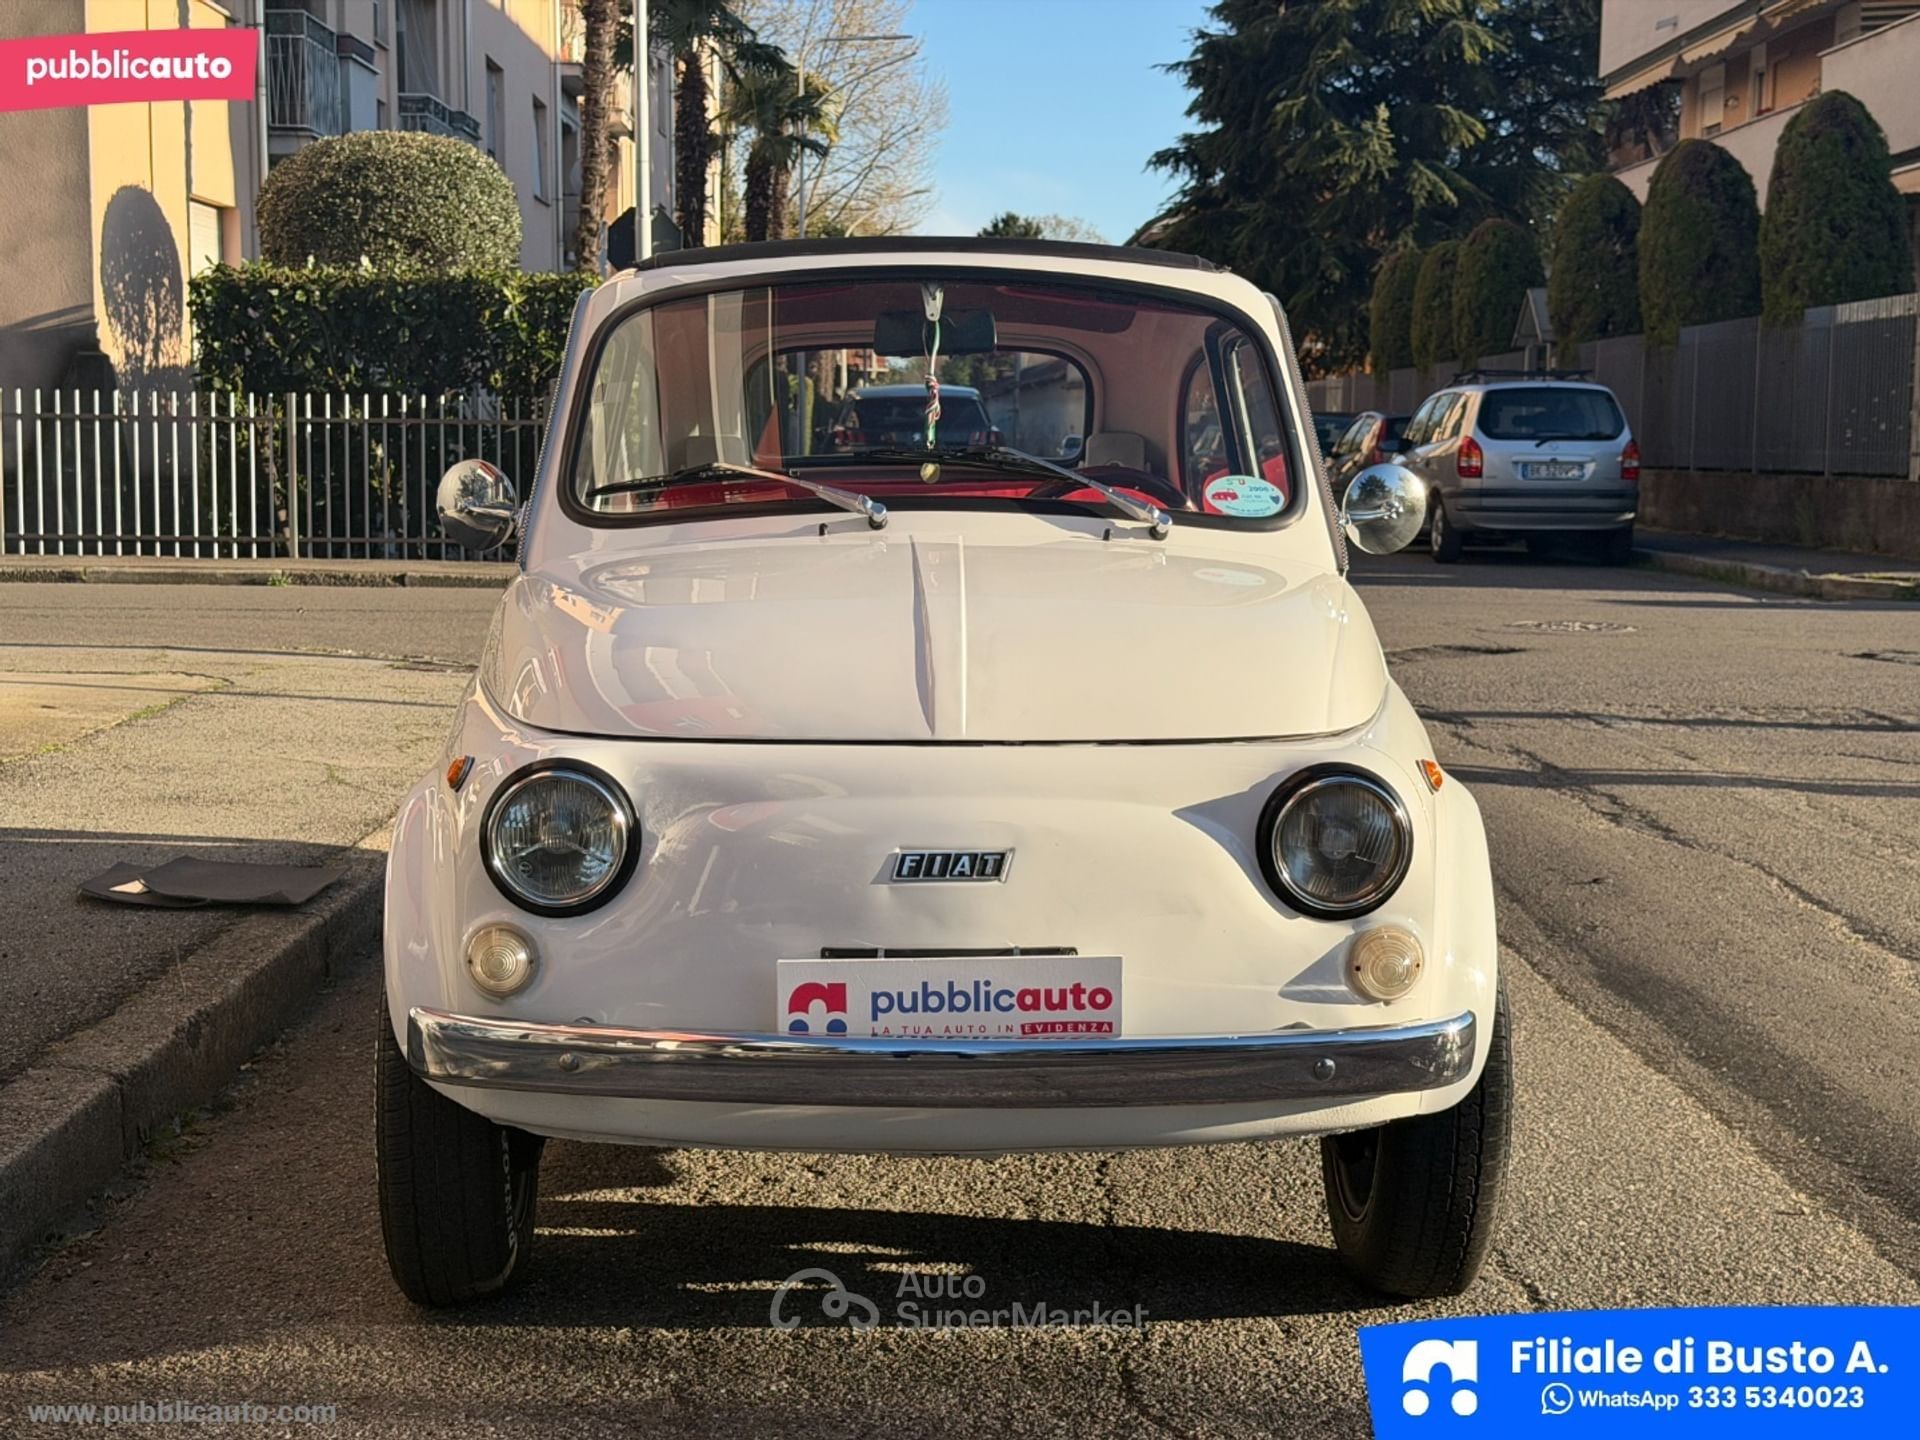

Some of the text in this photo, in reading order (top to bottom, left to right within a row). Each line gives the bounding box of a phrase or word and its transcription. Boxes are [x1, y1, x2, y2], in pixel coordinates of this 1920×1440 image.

[900, 855, 1002, 877] FIAT
[871, 980, 1114, 1022] pubblicauto
[871, 1022, 1111, 1036] LA TUA AUTO IN EVIDENZA
